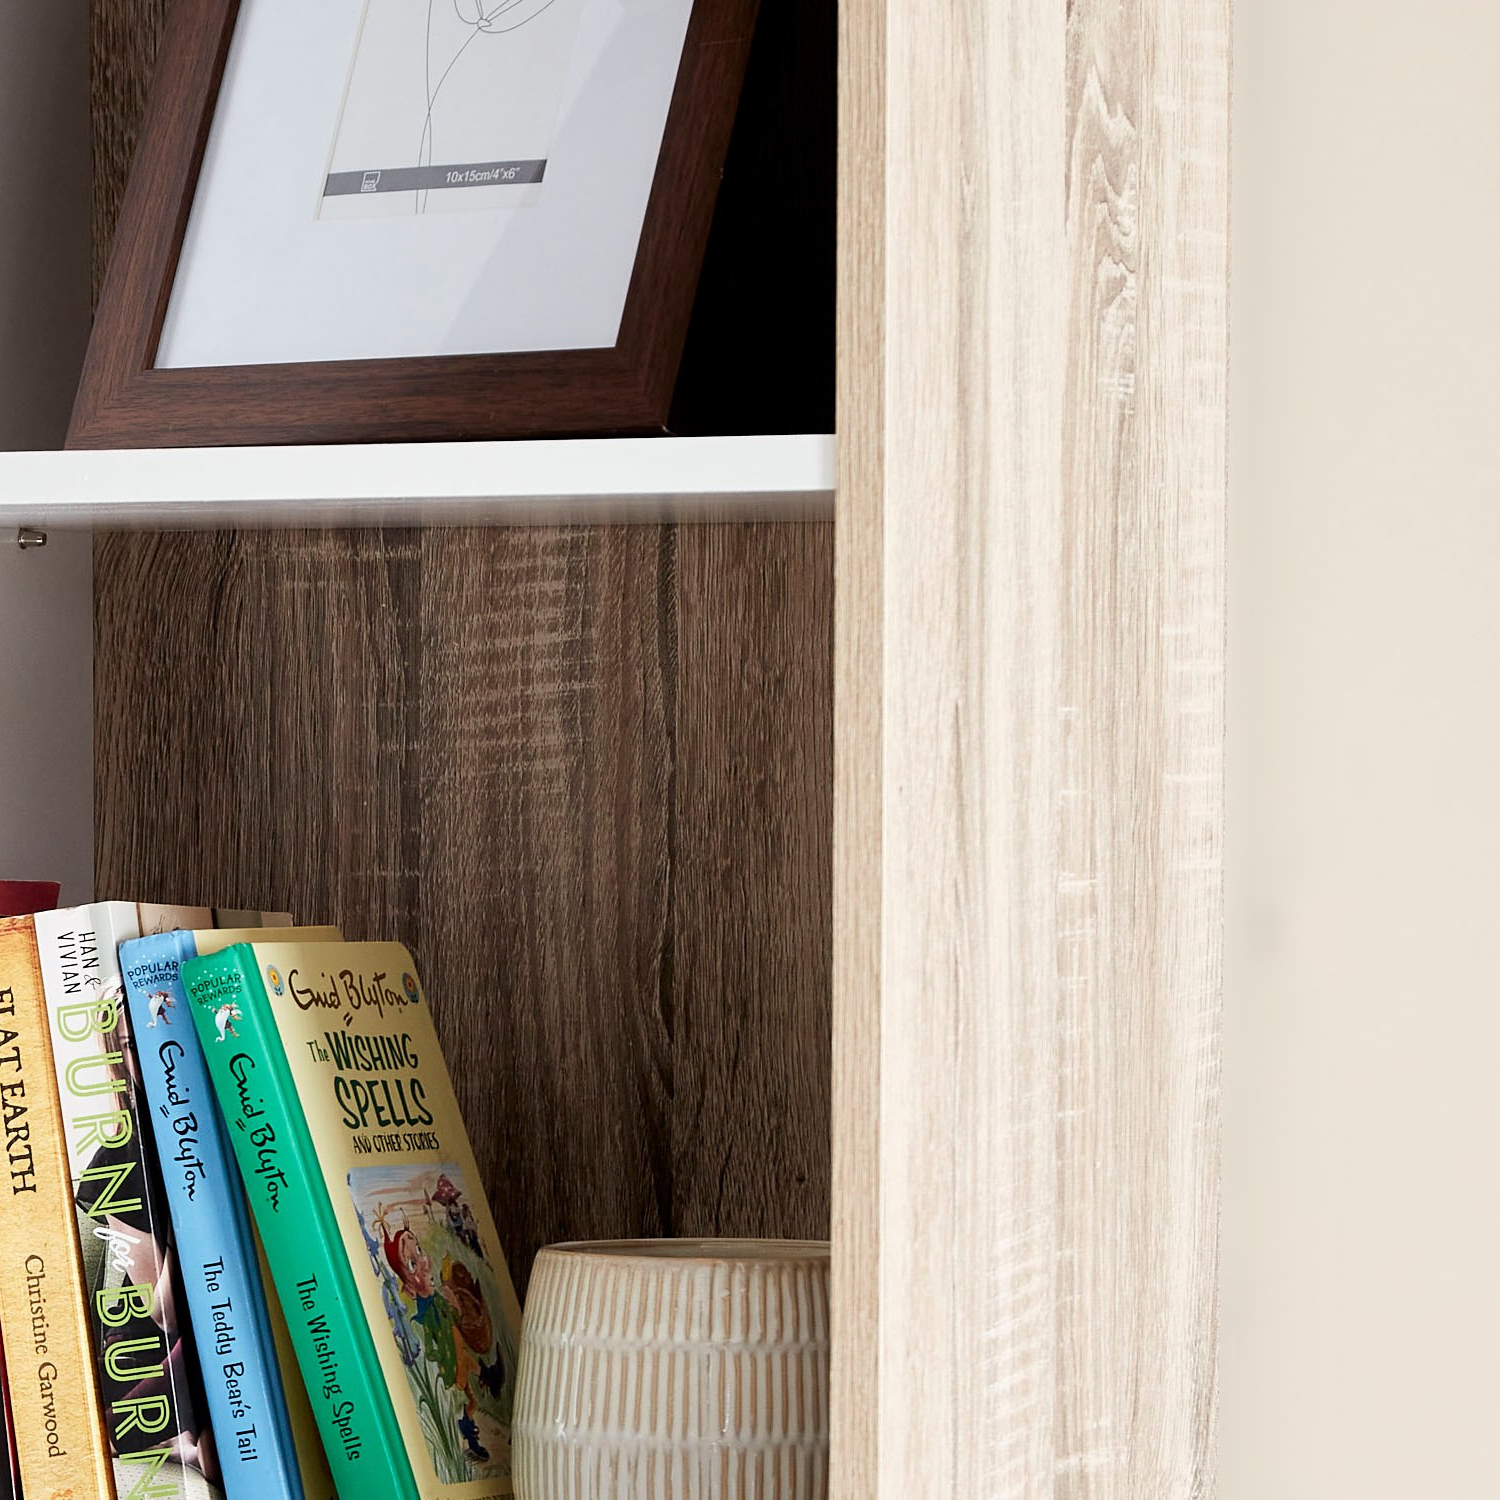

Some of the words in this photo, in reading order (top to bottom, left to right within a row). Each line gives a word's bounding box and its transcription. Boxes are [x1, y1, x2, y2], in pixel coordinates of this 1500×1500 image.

[57, 931, 82, 994] VIVIAN
[78, 931, 100, 968] HAN
[127, 960, 179, 981] POPULAR
[83, 974, 102, 989] &
[133, 973, 179, 989] REWARDS
[190, 973, 242, 998] POPULAR
[196, 984, 243, 1006] REWARDS
[288, 969, 342, 1011] Enid
[339, 969, 409, 1019] Blyton
[158, 1040, 190, 1107] Enid
[306, 1041, 330, 1063] The
[324, 1030, 419, 1072] WISHING
[57, 999, 143, 1218] BURN
[333, 1076, 434, 1130] SPELLS
[0, 1080, 37, 1196] EARTH
[173, 1111, 206, 1202] Blyton
[229, 1053, 265, 1119] Enid
[250, 1123, 288, 1213] Blyton
[353, 1135, 372, 1154] AND
[373, 1133, 402, 1151] OTHER
[403, 1132, 441, 1151] STORIES
[92, 1226, 141, 1273] for
[203, 1255, 225, 1293] The
[296, 1273, 319, 1312] The
[211, 1297, 236, 1356] Teddy
[25, 1254, 51, 1355] Christine
[38, 1361, 67, 1458] Garwood
[307, 1314, 343, 1400] Wishing
[96, 1282, 179, 1500] BURN
[223, 1361, 251, 1419] Bear's
[236, 1424, 258, 1462] Tail
[332, 1401, 362, 1461] Spells
